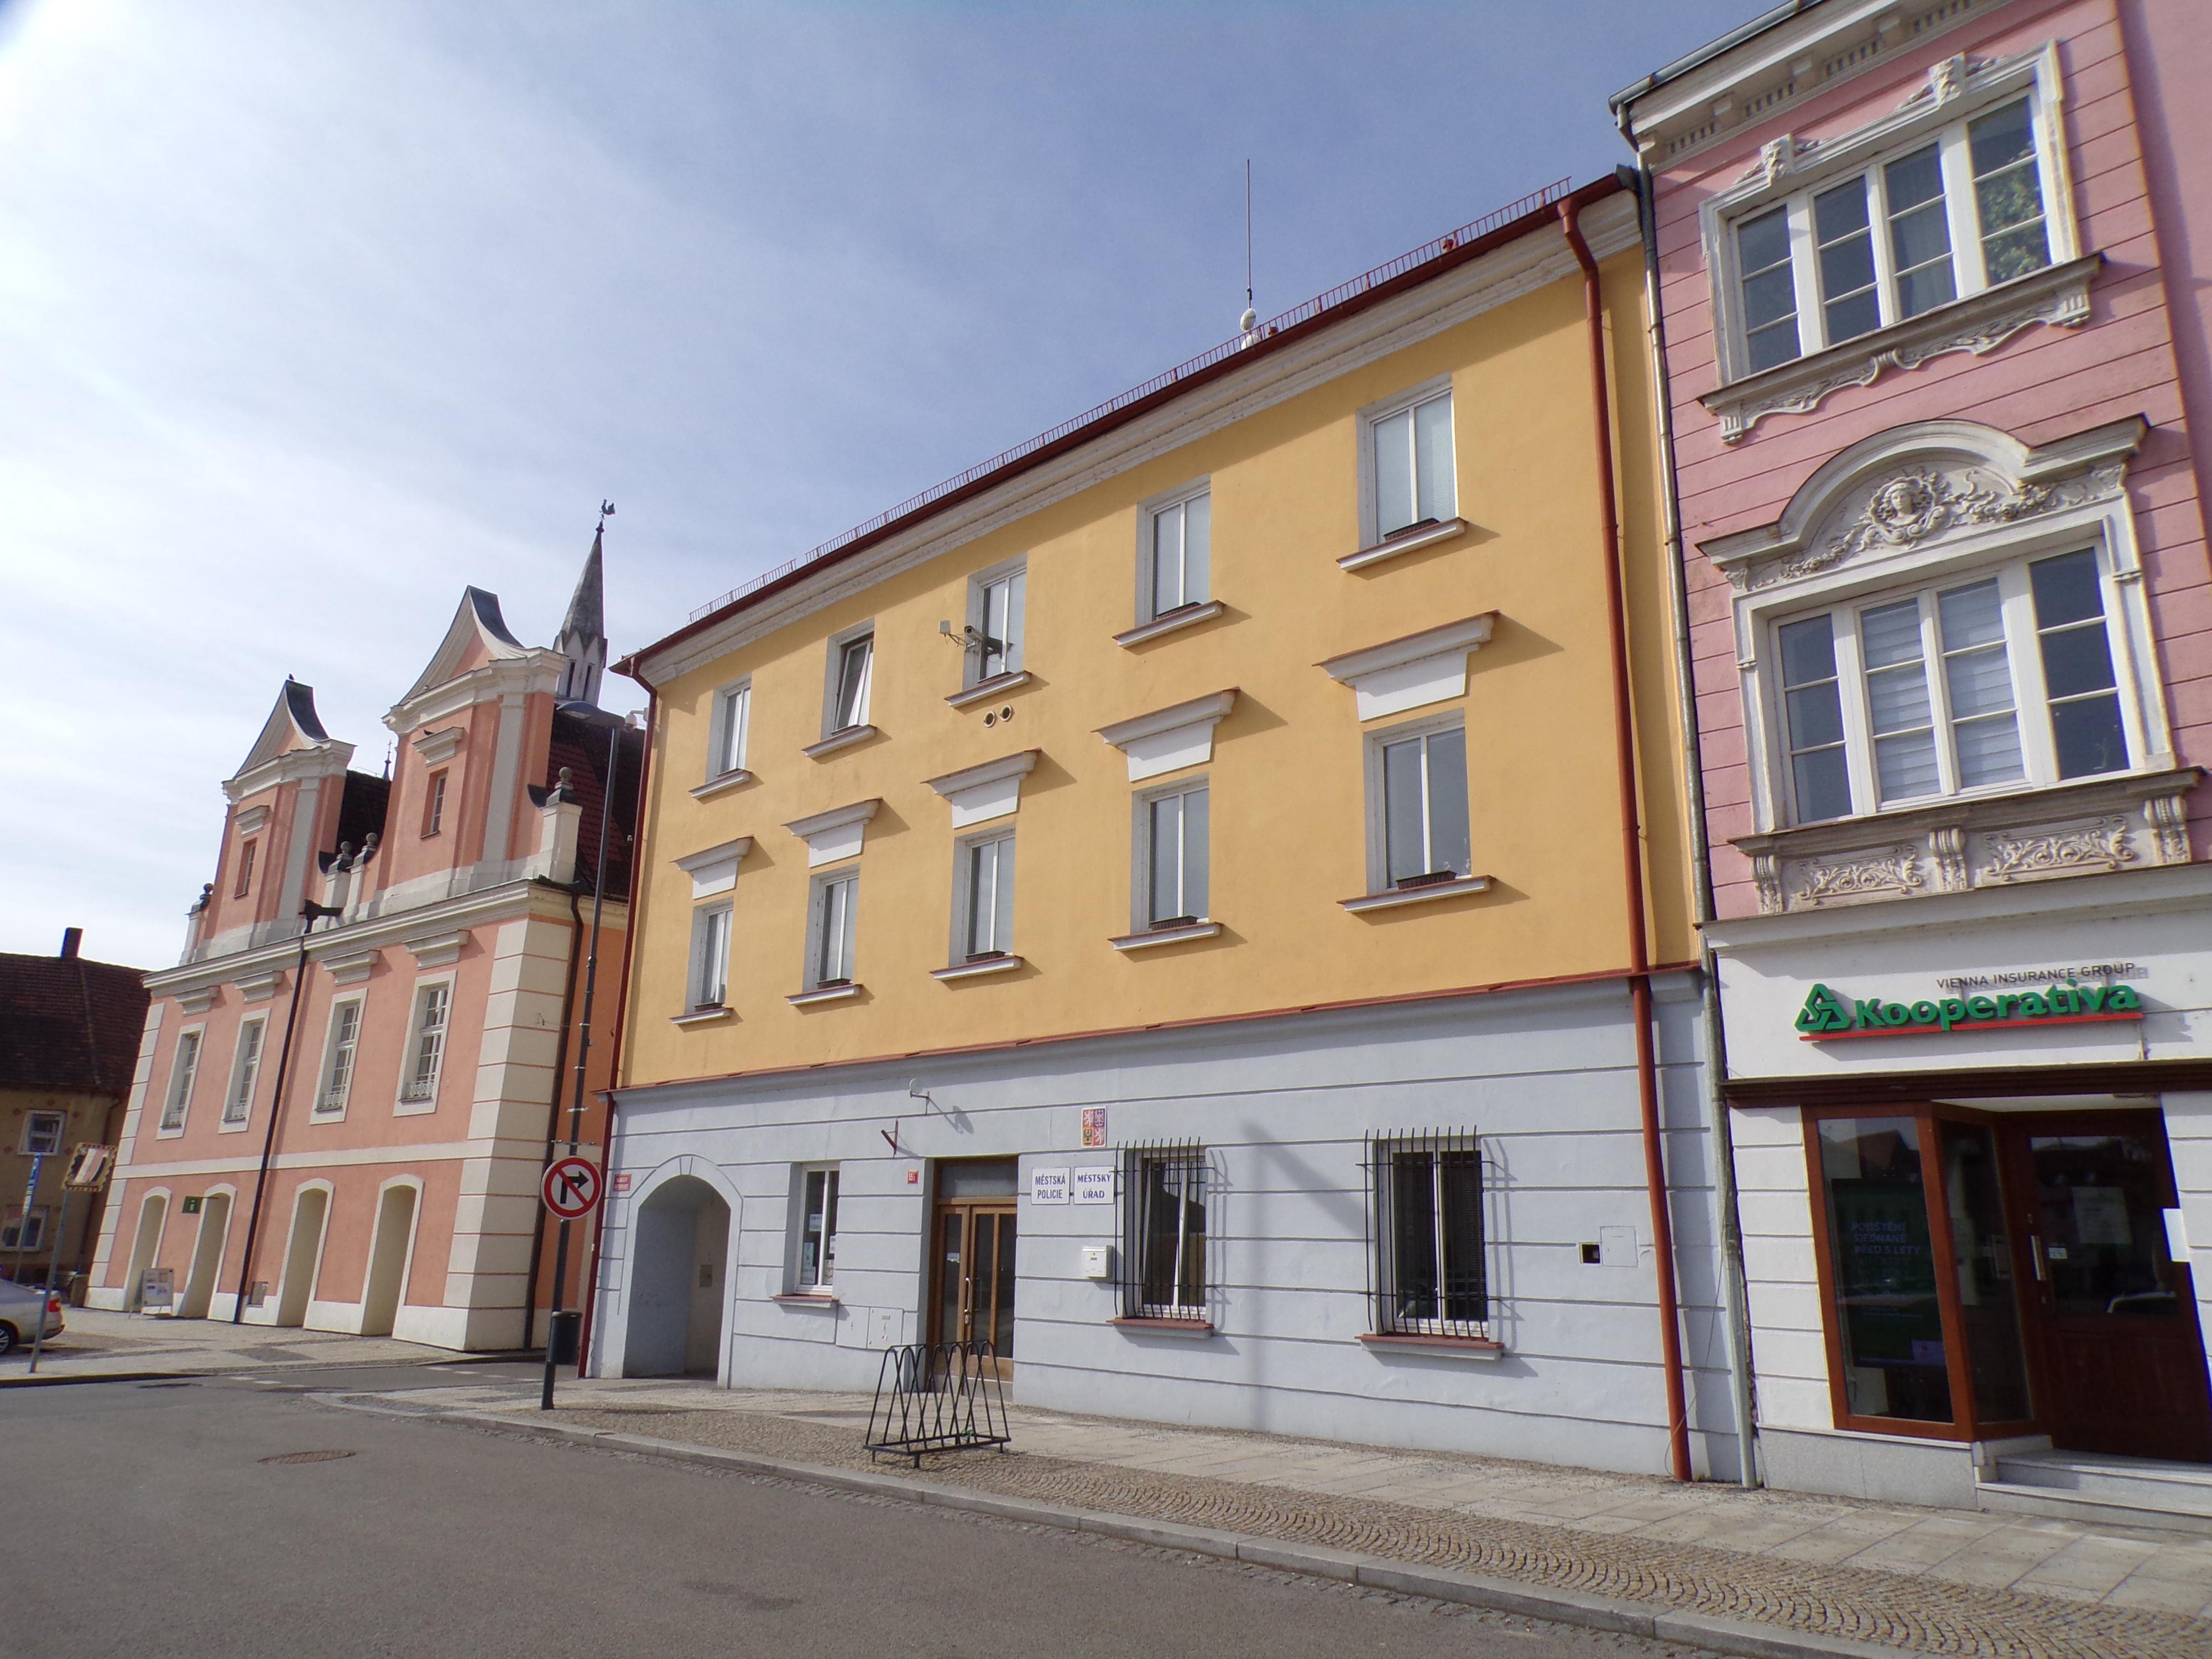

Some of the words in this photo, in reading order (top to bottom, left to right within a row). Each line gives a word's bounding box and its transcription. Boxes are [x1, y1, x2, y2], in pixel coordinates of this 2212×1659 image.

[1937, 977, 1989, 988] VIENNA
[1994, 968, 2075, 984] INSURANCE
[2080, 963, 2135, 977] GROUP
[1855, 978, 2141, 1031] Kooperativa
[1035, 1173, 1066, 1185] MĚSTSKÁ
[1037, 1189, 1062, 1199] POLICIE
[1083, 1188, 1105, 1199] ÚŘAD
